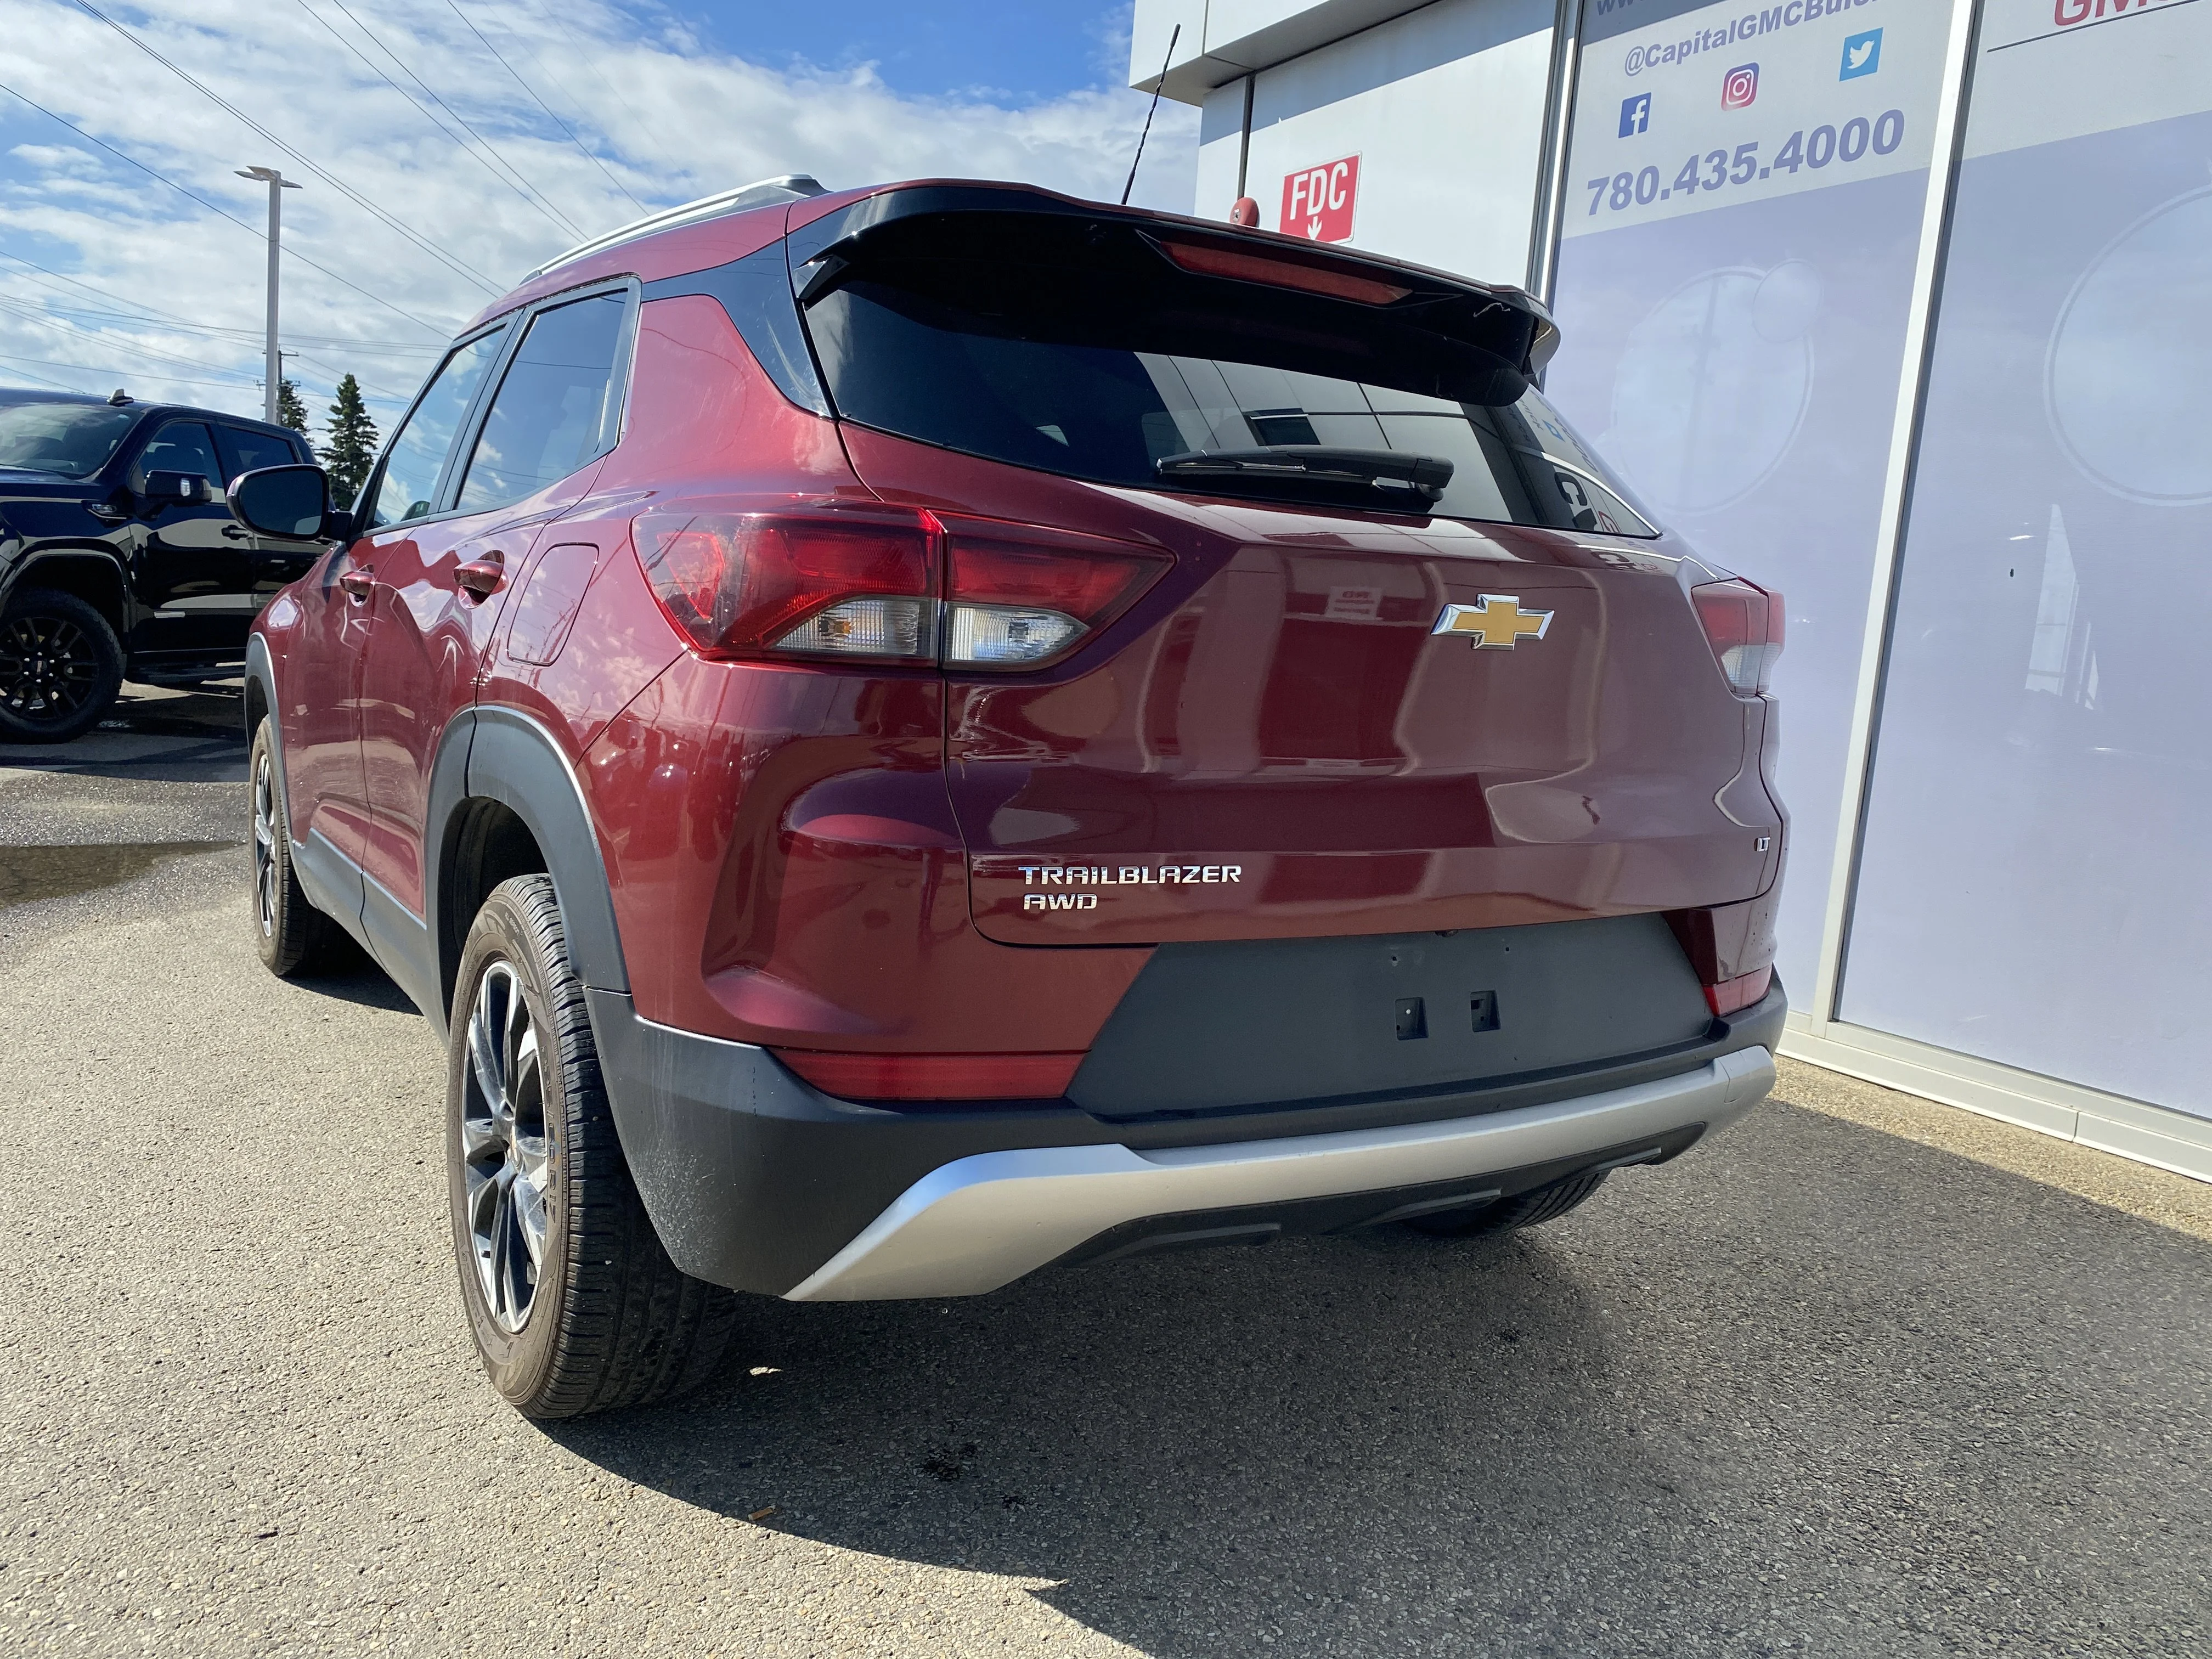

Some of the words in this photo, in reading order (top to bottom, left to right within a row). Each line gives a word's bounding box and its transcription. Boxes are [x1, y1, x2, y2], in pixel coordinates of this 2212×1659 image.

[1587, 109, 1905, 216] 780.435.4000
[1290, 162, 1348, 220] FDC
[1757, 837, 1771, 851] LT
[1018, 865, 1242, 885] TRAILBLAZER
[1024, 893, 1098, 910] AWD
